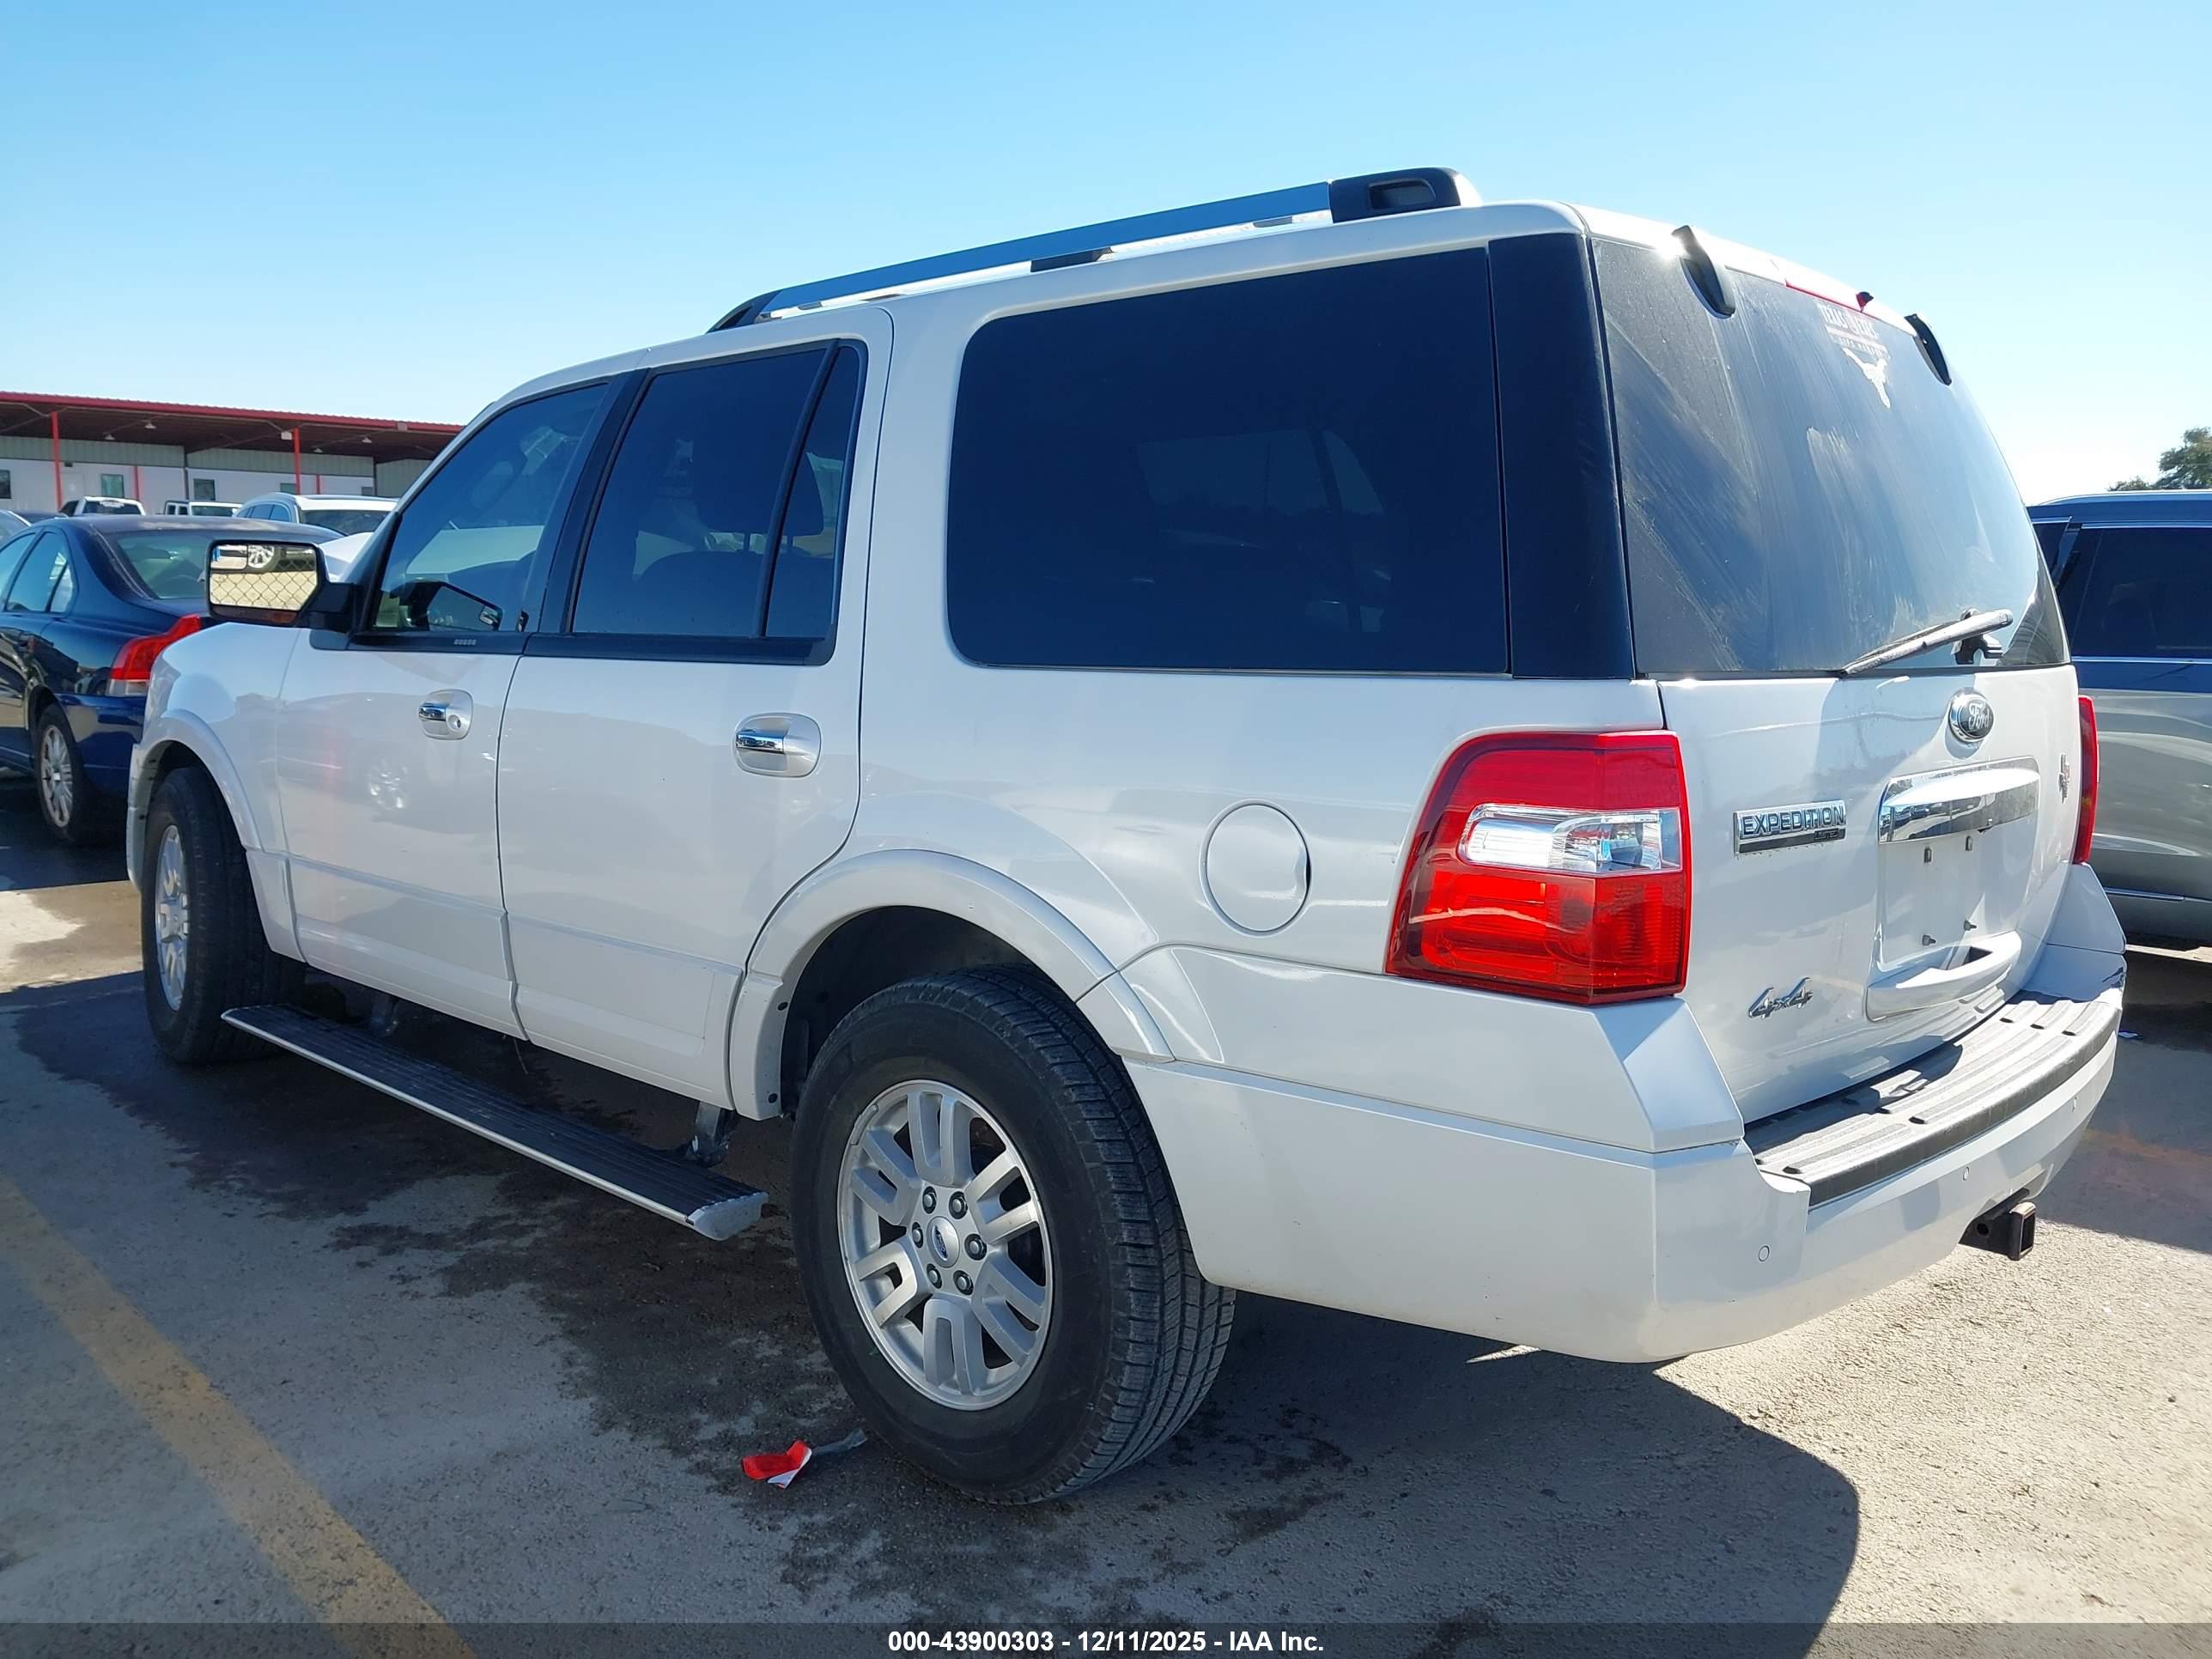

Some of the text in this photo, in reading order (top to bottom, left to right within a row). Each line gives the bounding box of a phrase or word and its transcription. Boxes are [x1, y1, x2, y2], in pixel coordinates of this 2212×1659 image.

[1968, 702, 1990, 730] Ford
[1740, 805, 1845, 839] EXPEDITION
[1748, 976, 1814, 1019] 4x4
